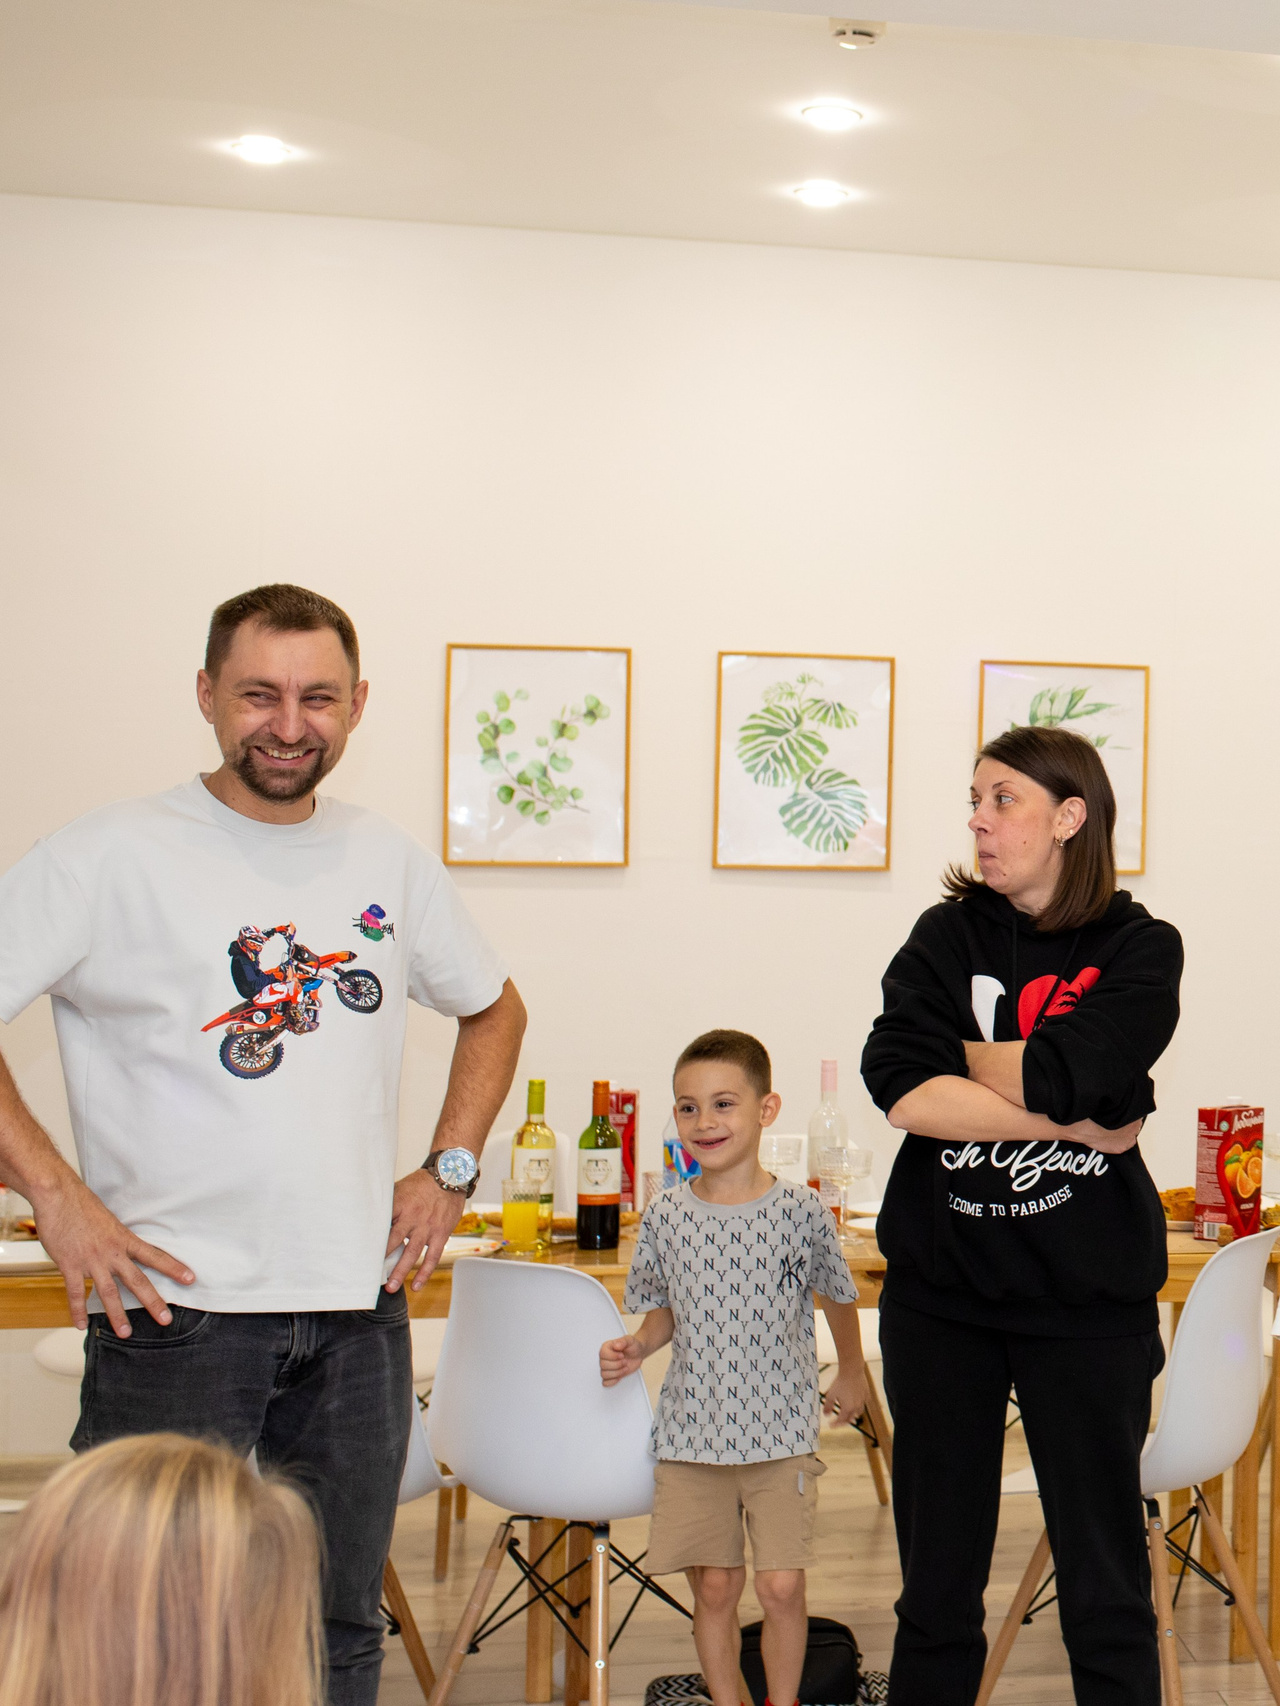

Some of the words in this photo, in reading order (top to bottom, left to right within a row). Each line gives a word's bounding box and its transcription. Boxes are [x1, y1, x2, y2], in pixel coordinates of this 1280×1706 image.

[991, 1140, 1109, 1192] Beach
[989, 1204, 1006, 1217] TO
[1010, 1184, 1073, 1217] PARADISE
